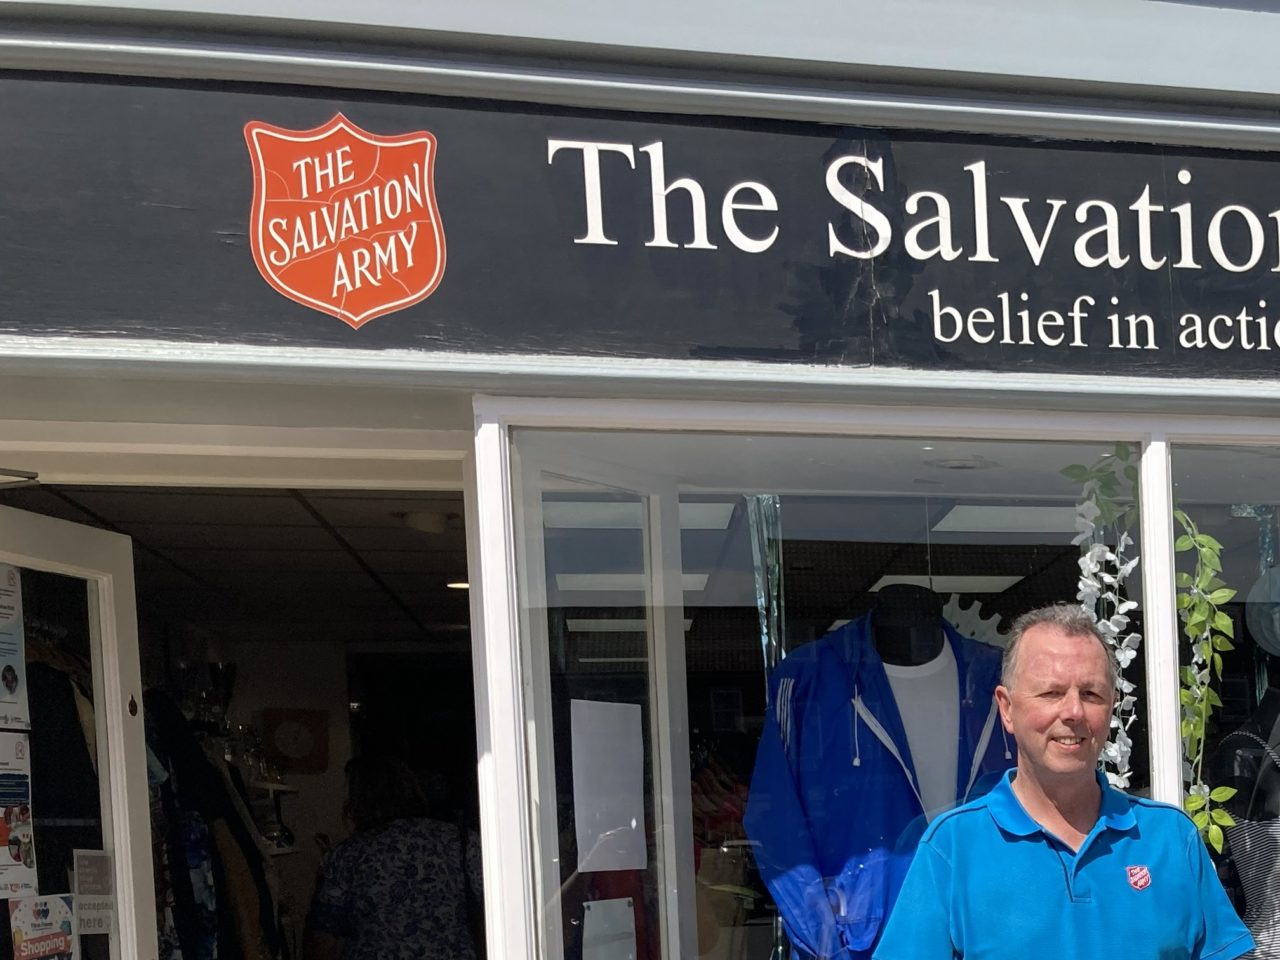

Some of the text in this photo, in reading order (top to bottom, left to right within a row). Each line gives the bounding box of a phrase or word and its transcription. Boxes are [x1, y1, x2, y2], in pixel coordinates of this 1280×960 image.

[292, 146, 355, 199] THE
[547, 139, 780, 254] The
[269, 163, 424, 267] SALVATION
[331, 222, 419, 298] ARMY
[927, 289, 1096, 347] belief
[1108, 297, 1159, 350] in
[21, 935, 65, 956] Shopping
[79, 916, 104, 929] here
